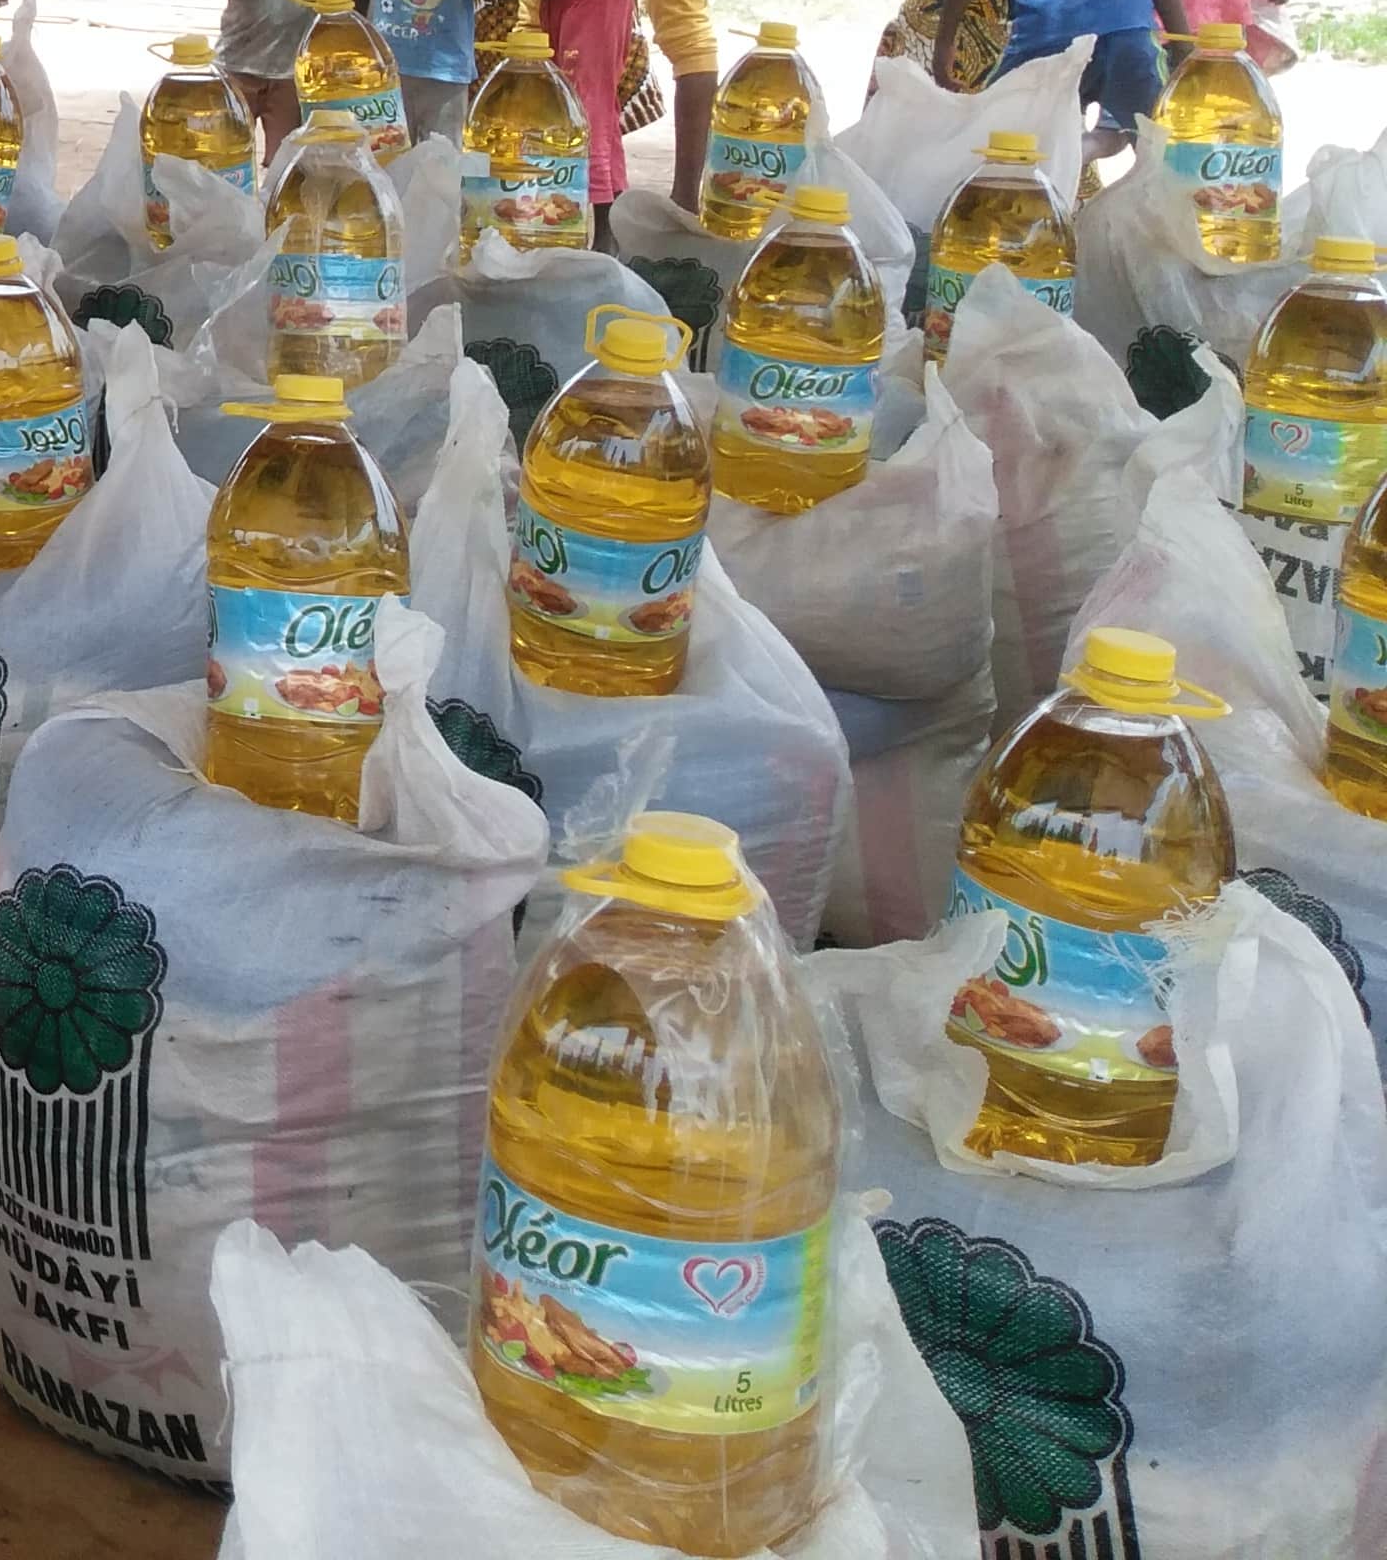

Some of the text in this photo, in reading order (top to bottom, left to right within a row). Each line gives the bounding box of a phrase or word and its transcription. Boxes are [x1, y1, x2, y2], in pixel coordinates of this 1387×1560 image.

[1200, 143, 1277, 181] Oléor
[749, 362, 851, 400] Oléor
[1284, 493, 1314, 508] Litres
[1295, 483, 1305, 495] 5
[28, 1210, 116, 1258] MAHMÛD
[10, 1270, 130, 1351] VAKFI
[0, 1327, 208, 1463] RAMAZAN
[735, 1371, 751, 1394] 5
[714, 1394, 763, 1414] Litres
